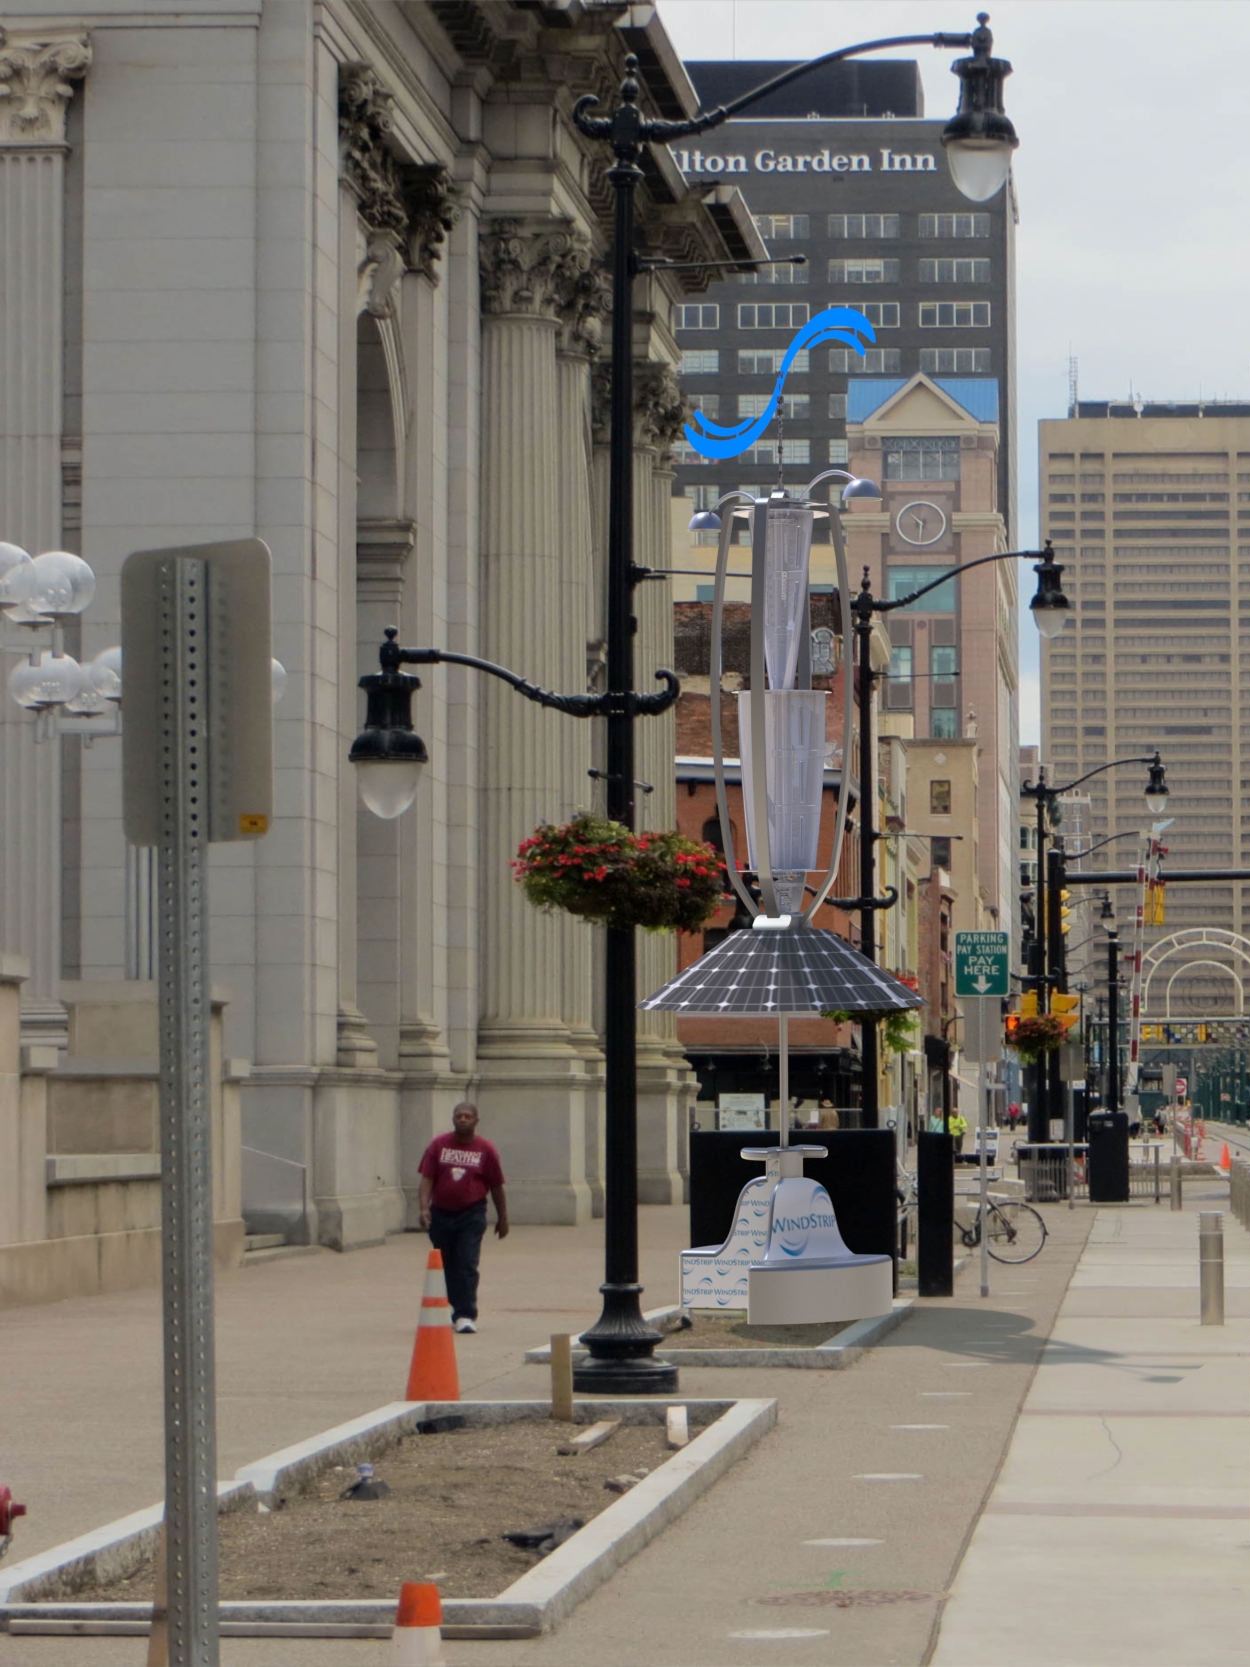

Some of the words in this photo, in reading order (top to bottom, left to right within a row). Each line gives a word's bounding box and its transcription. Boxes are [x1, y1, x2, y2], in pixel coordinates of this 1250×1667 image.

[673, 149, 749, 173] lton
[754, 149, 872, 173] Garden
[879, 149, 937, 172] Inn
[960, 934, 1004, 944] PARKING
[957, 944, 972, 954] PAY
[976, 944, 1007, 954] STATION
[968, 955, 995, 965] PAY
[964, 965, 1000, 975] HERE
[772, 1213, 836, 1234] WINDSTRIP
[683, 1258, 713, 1266] INDSTRIP
[714, 1258, 750, 1267] WINDSTRIP
[683, 1288, 713, 1296] INDSTRIP
